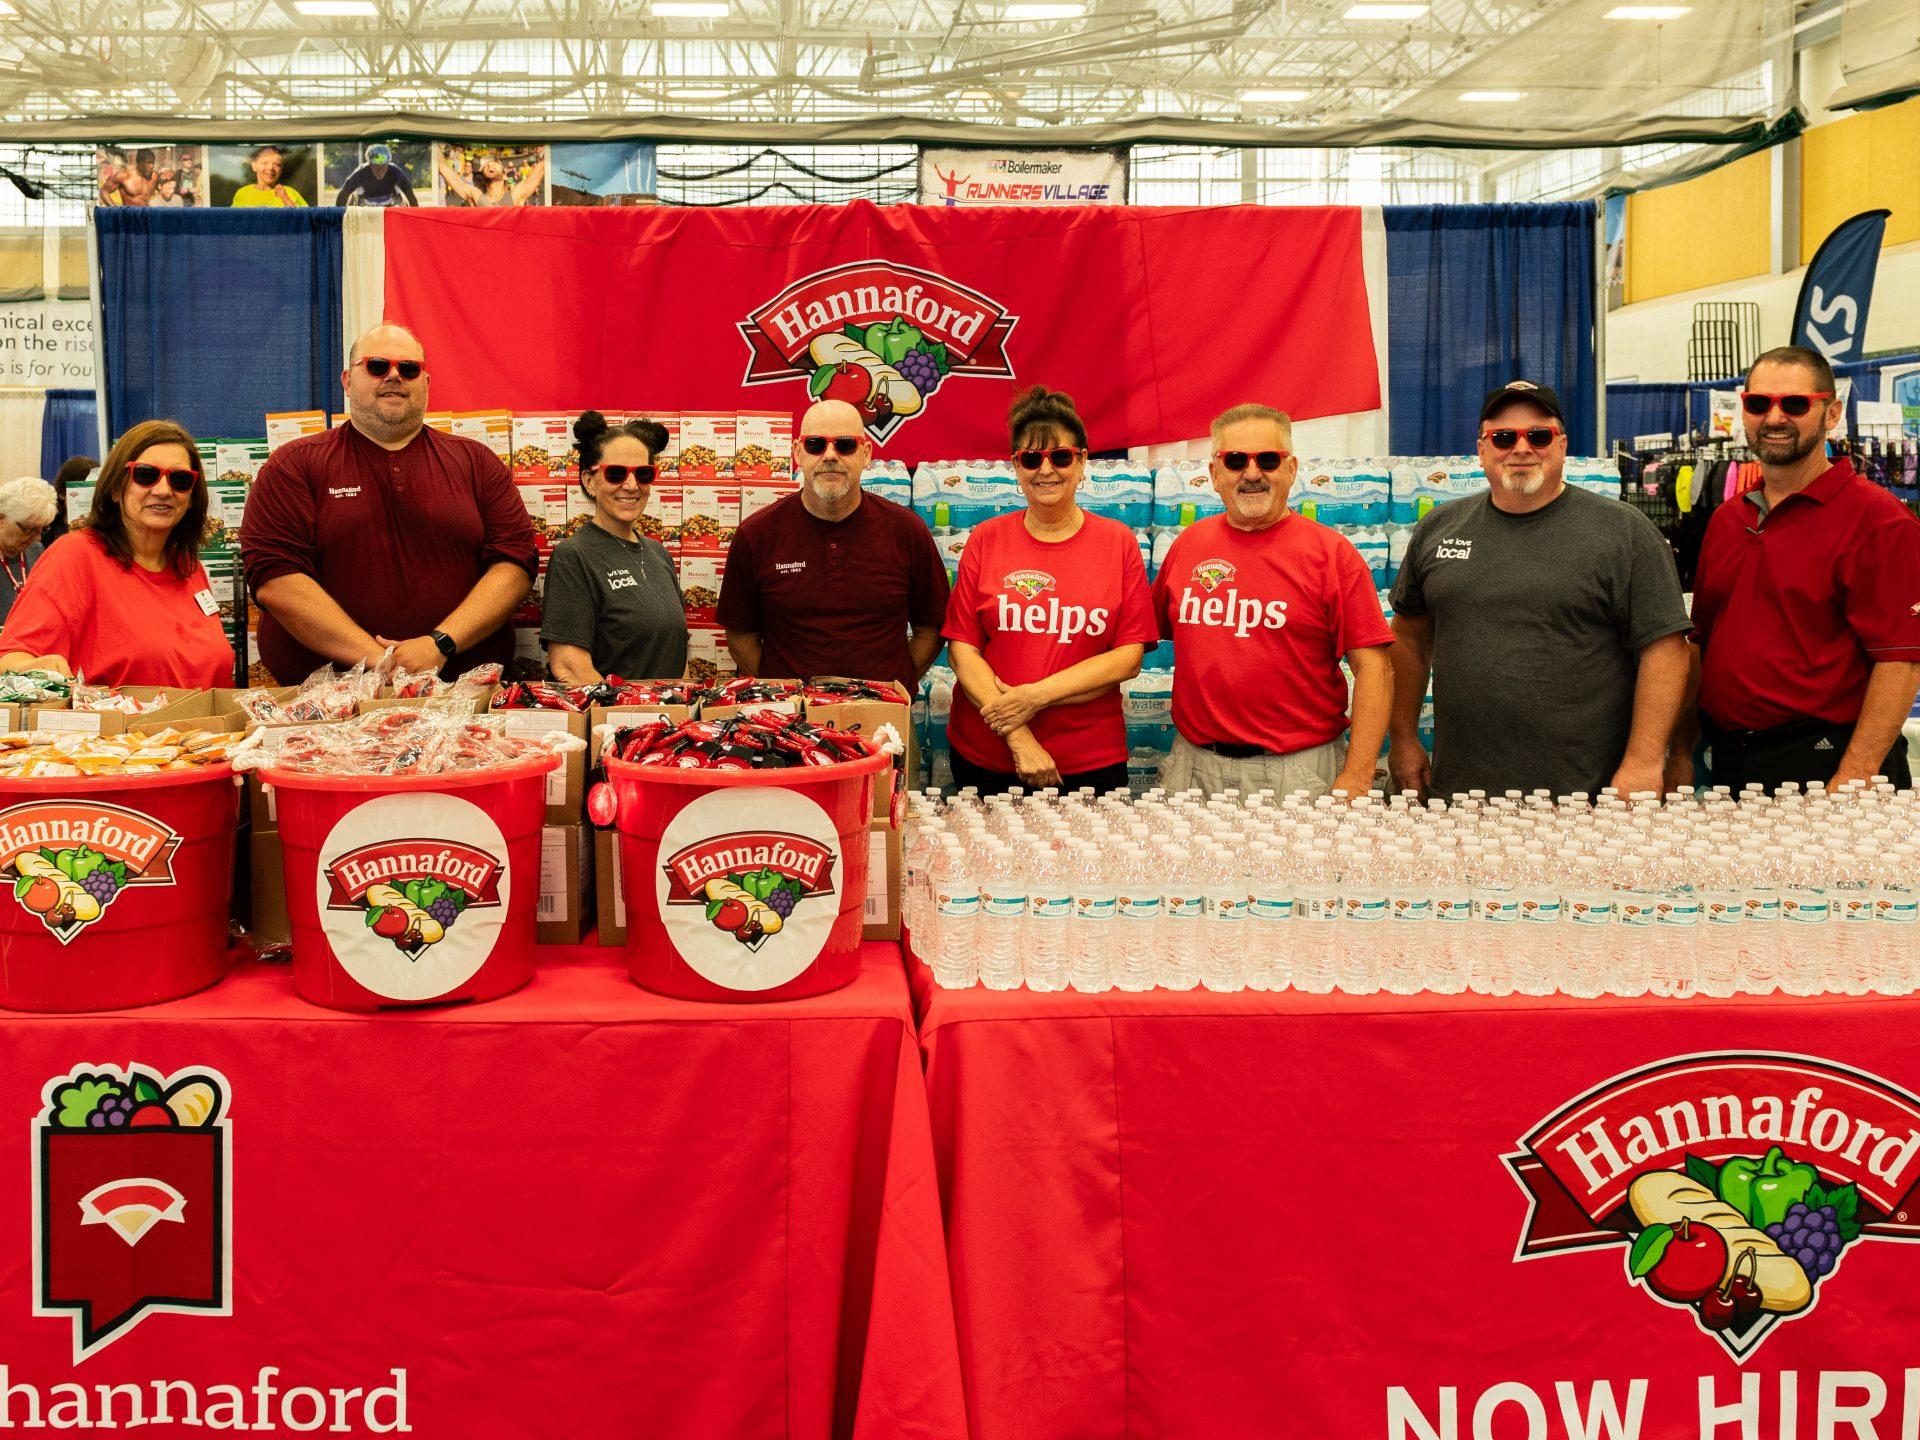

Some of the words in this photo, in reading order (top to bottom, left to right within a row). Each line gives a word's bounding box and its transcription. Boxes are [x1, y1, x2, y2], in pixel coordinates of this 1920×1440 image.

[1008, 160, 1062, 175] Boilermaker
[769, 284, 986, 349] Hannaford
[0, 336, 16, 350] n
[24, 333, 57, 352] the
[11, 359, 23, 375] is
[27, 360, 55, 378] for
[328, 485, 361, 495] Hannaford
[968, 483, 998, 493] water
[1093, 482, 1121, 492] water
[1335, 481, 1365, 492] water
[1451, 477, 1482, 488] water
[1455, 538, 1472, 546] love
[1436, 545, 1471, 559] local
[775, 560, 806, 570] Hannaford
[608, 575, 638, 590] local
[1009, 573, 1051, 584] Hannaford
[997, 594, 1109, 644] helps
[1178, 587, 1288, 638] helps
[1131, 700, 1166, 710] water
[339, 849, 490, 891] Hannaford
[677, 841, 823, 886] Hannaford
[1556, 1087, 1920, 1195] Hannaford
[0, 1365, 412, 1433] hannaford
[1386, 1378, 1649, 1440] NOW
